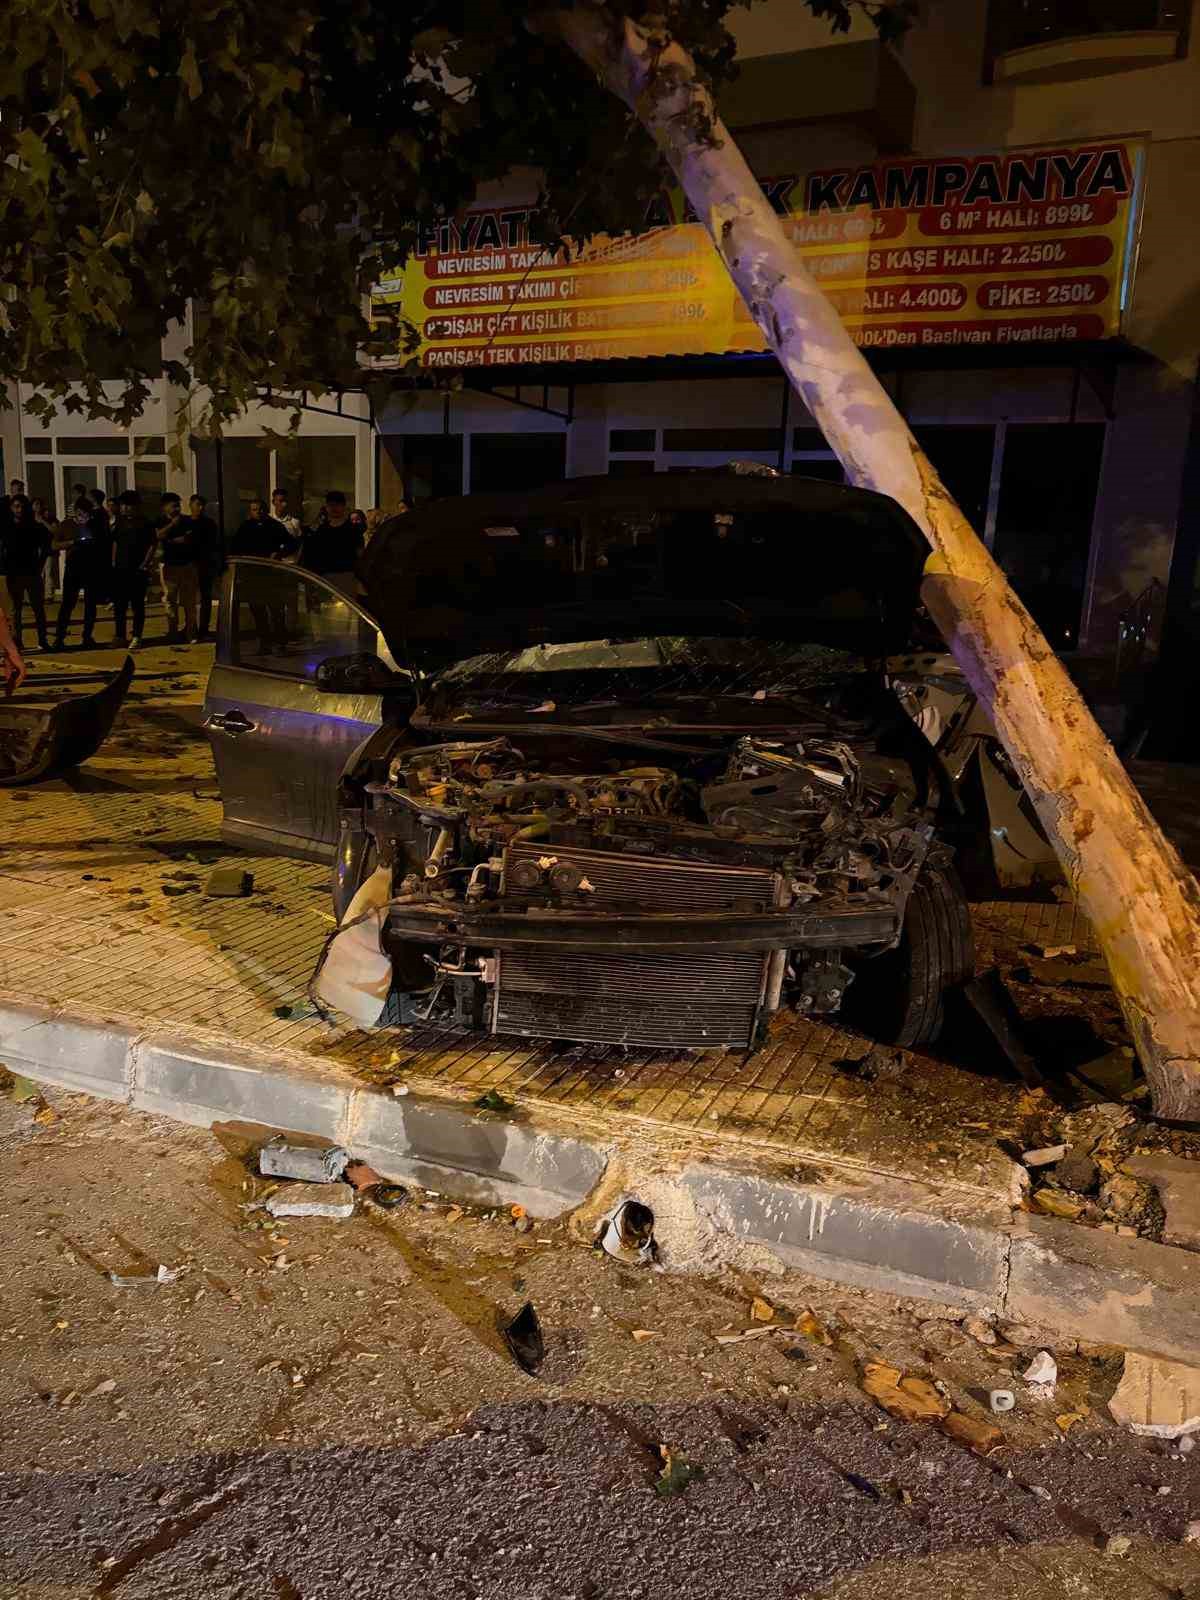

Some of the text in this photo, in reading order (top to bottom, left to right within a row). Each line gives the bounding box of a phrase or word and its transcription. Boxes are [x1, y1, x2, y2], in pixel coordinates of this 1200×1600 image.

[808, 149, 1129, 217] KAMPANYA
[939, 211, 951, 230] 6
[986, 207, 1038, 229] HALI:
[1045, 203, 1094, 225] 899₺
[437, 251, 506, 275] NEVRESİM
[886, 249, 938, 273] KAŞE
[943, 247, 995, 268] HALI:
[435, 283, 503, 305] NEVRESİM
[507, 281, 556, 300] TAKIMI
[900, 288, 962, 307] 4.400₺
[987, 283, 1096, 306] PİKE: 250₺
[427, 316, 483, 338] PDİŞAH
[521, 309, 573, 334] KİŞİLİK
[488, 347, 515, 365] TEK
[519, 342, 571, 364] KİŞİLİK
